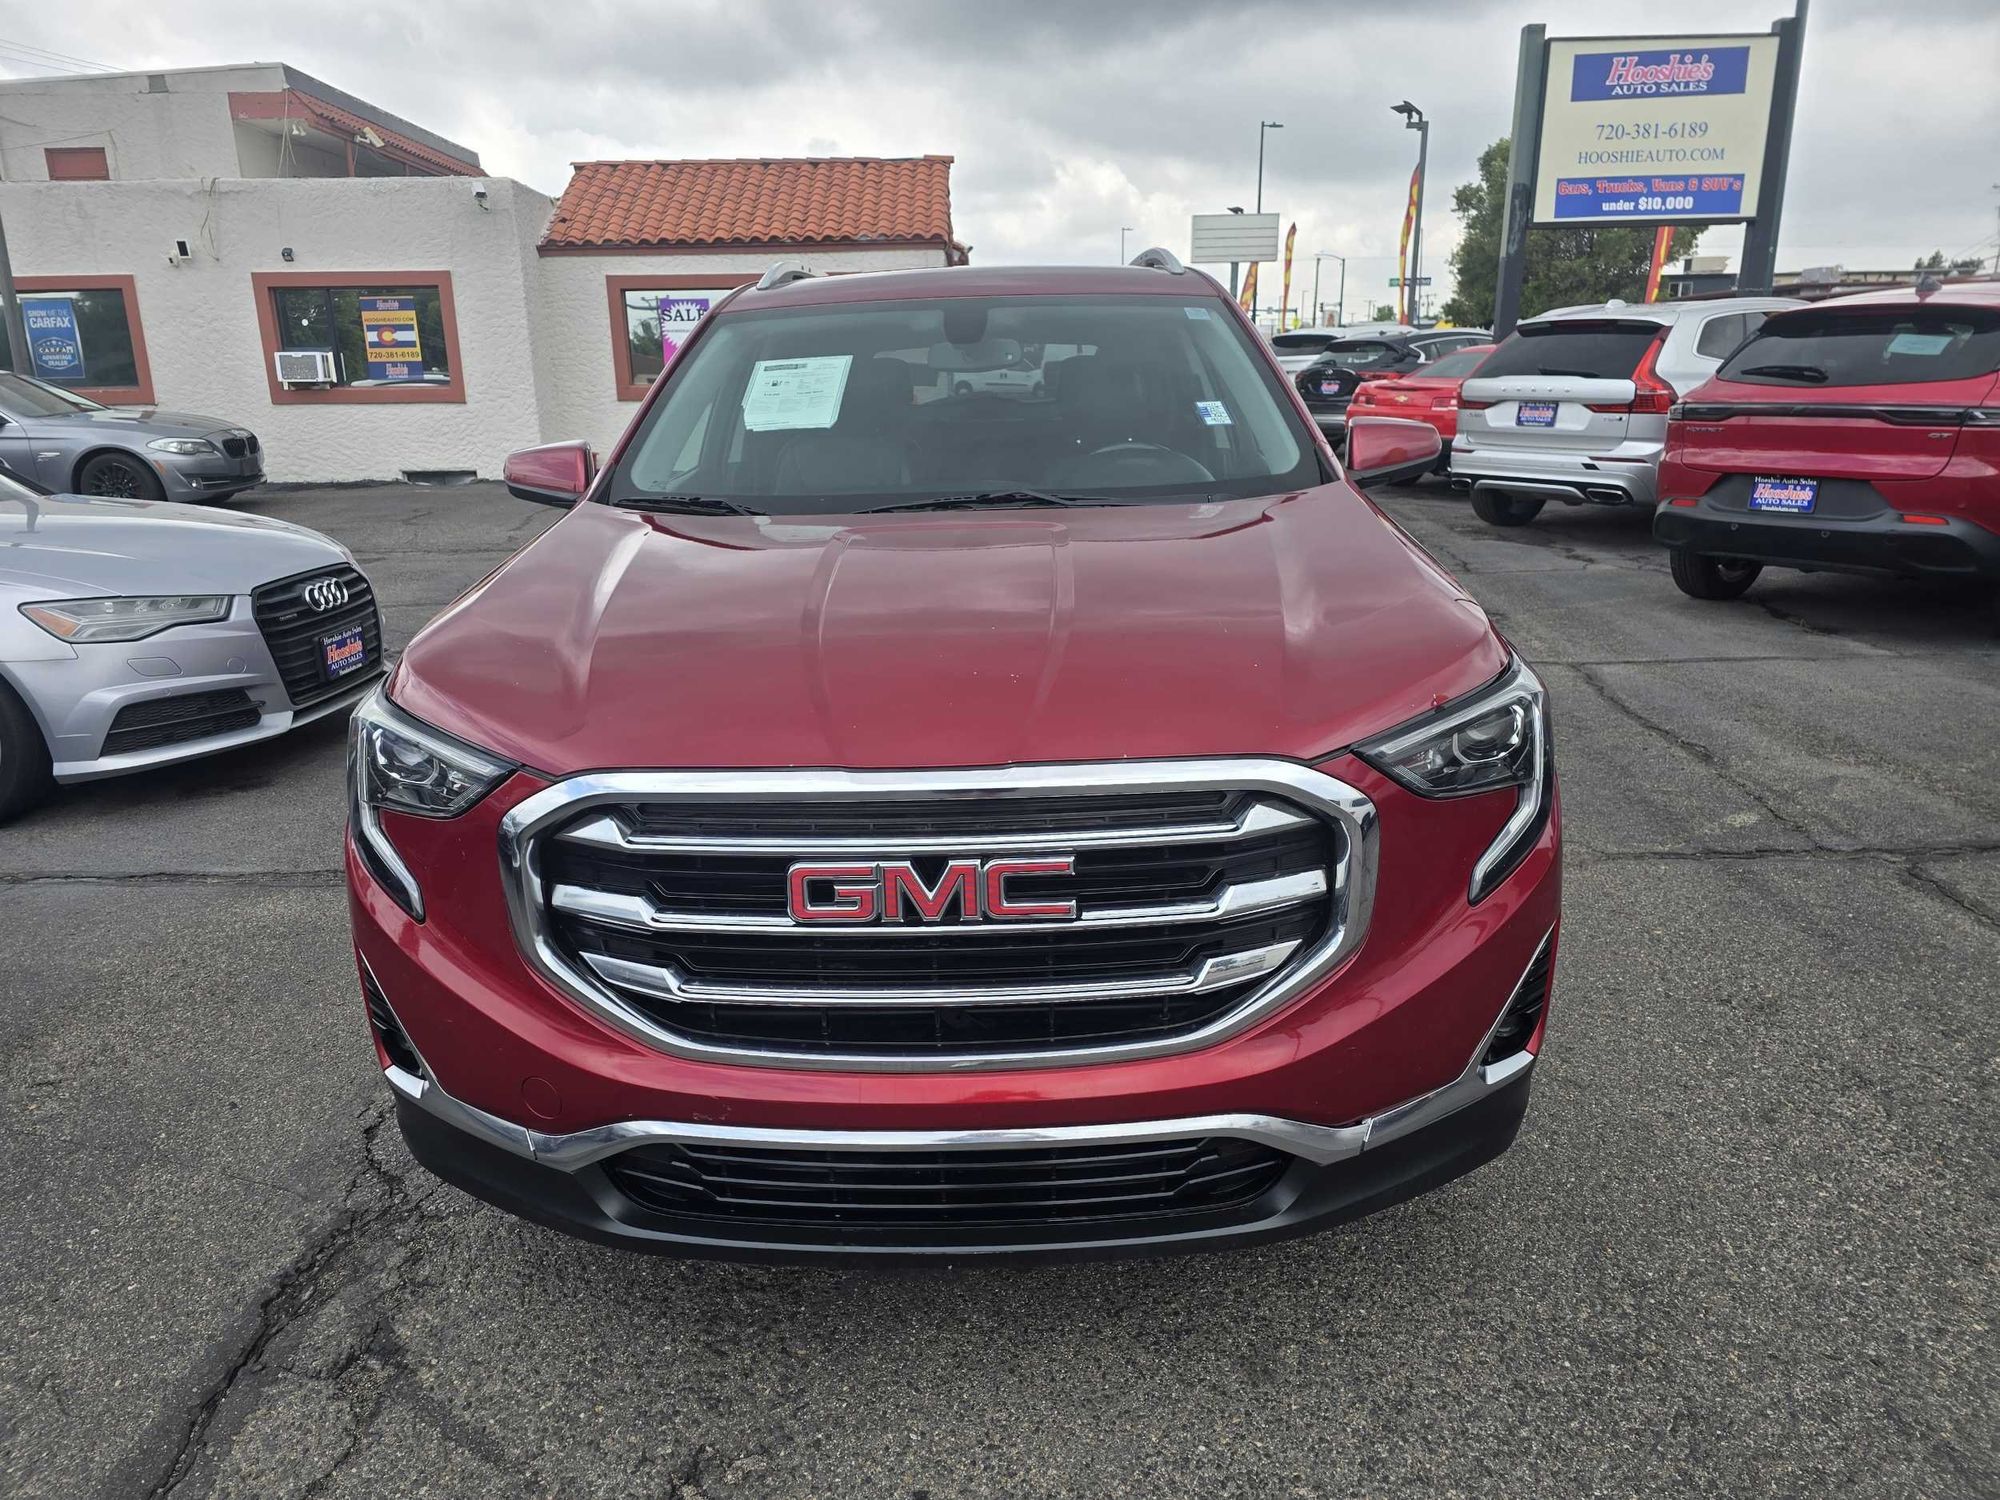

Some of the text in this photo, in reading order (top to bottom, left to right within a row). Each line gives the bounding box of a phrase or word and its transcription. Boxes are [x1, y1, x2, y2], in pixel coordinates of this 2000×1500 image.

[1605, 54, 1715, 85] Hooshie's
[1612, 82, 1708, 95] AUTO SALES
[1596, 121, 1709, 140] 720-381-6189
[1578, 148, 1725, 164] HOOSHIEAUTO.COM
[1558, 182, 1593, 196] Cars,
[1596, 179, 1648, 194] Trucks,
[1652, 178, 1685, 192] Vans
[1701, 176, 1742, 191] SUV's
[1602, 196, 1694, 211] under $10,000
[30, 316, 71, 328] CARFAX
[662, 308, 707, 322] SALE
[1754, 484, 1813, 500] Hooshie's
[327, 636, 362, 664] Hooshie's
[331, 652, 362, 670] AUTO SALES
[787, 856, 1077, 923] GMC
